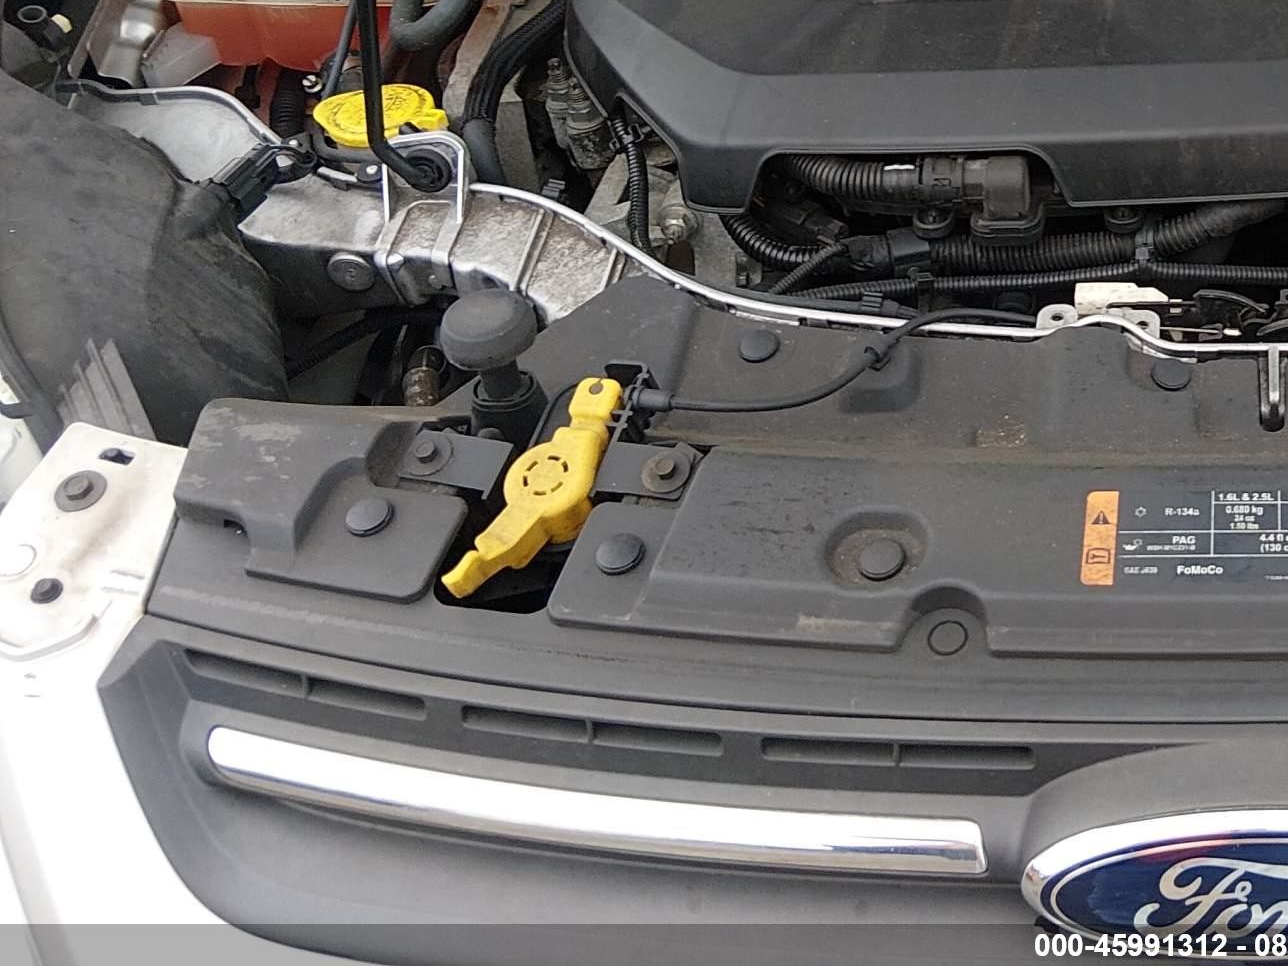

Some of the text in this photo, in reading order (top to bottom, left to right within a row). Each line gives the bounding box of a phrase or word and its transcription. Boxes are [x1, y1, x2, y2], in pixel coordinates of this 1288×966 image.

[1241, 492, 1250, 501] &
[1164, 507, 1200, 516] R-134a
[1251, 505, 1264, 515] kg
[1172, 535, 1196, 544] PAG
[1260, 543, 1282, 553] (130
[1176, 564, 1224, 575] FoMoCo
